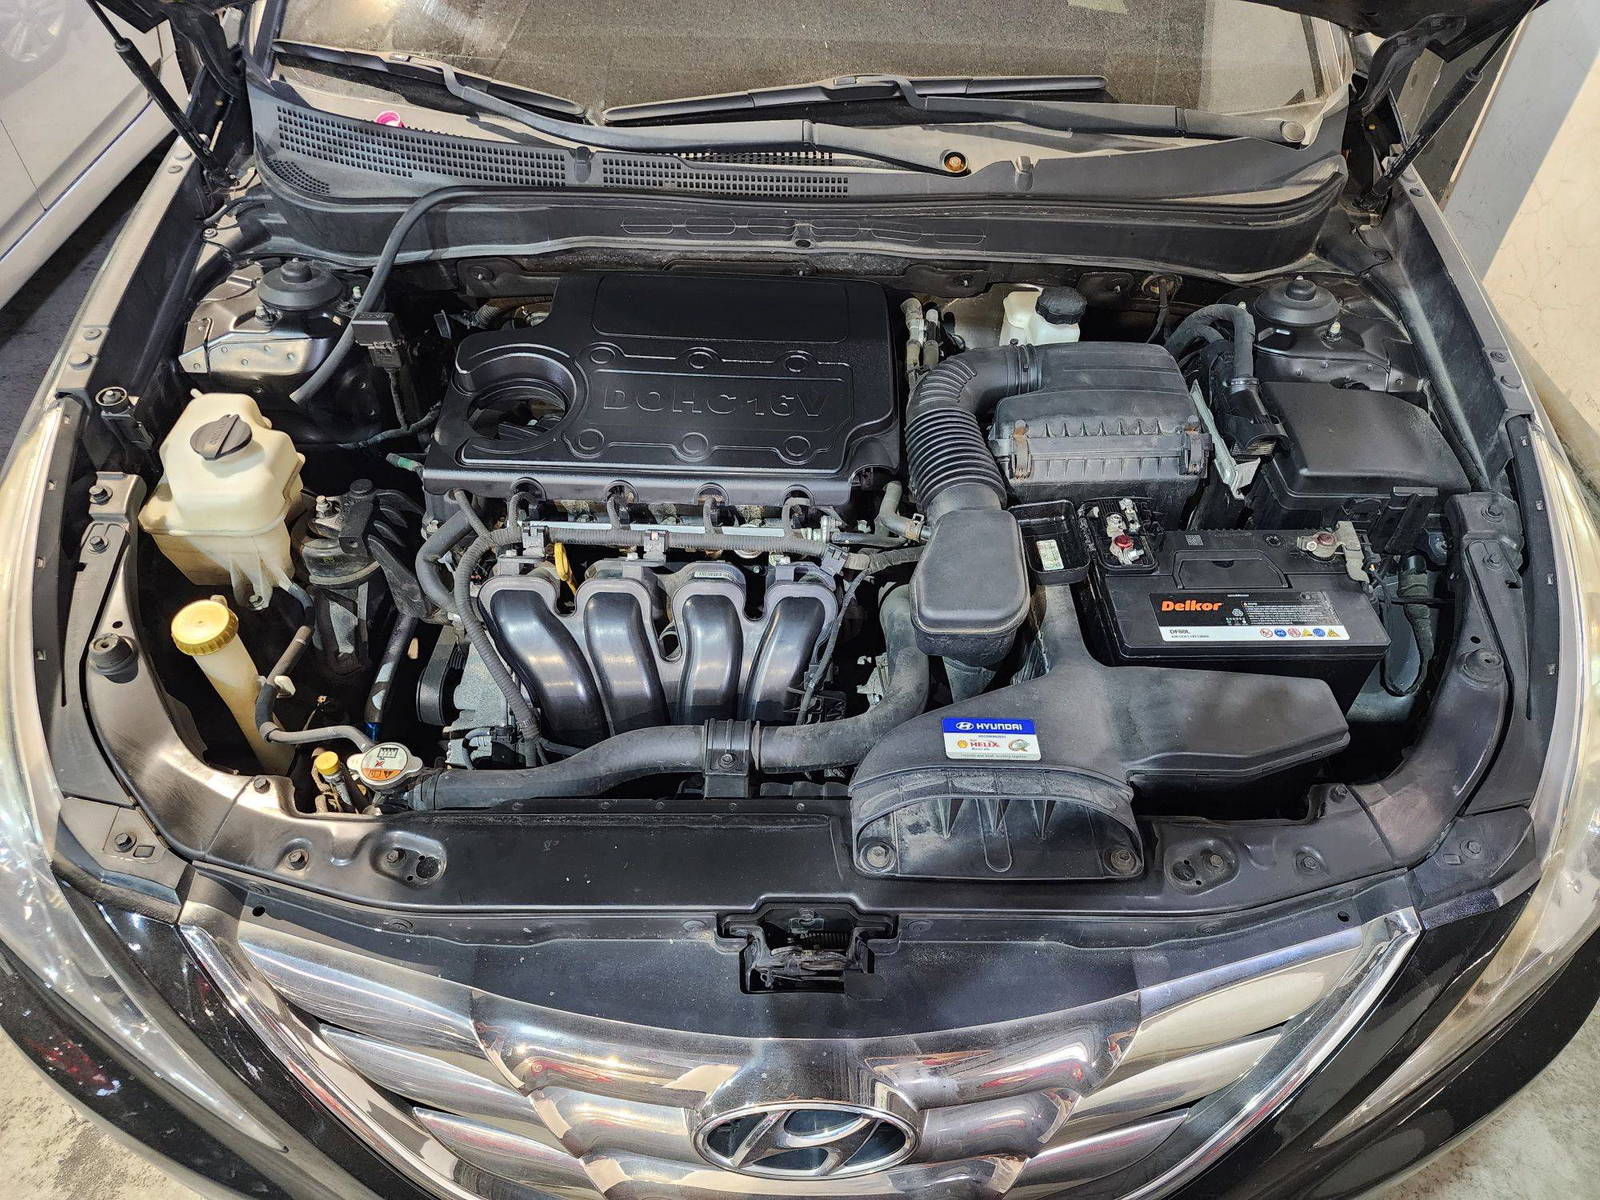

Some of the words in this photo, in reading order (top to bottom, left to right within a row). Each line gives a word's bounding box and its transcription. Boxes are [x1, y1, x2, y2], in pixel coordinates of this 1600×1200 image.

[603, 384, 737, 414] DOHC
[745, 391, 830, 417] 16V
[1161, 600, 1224, 611] Delkor
[976, 723, 1023, 731] HYUNDAI
